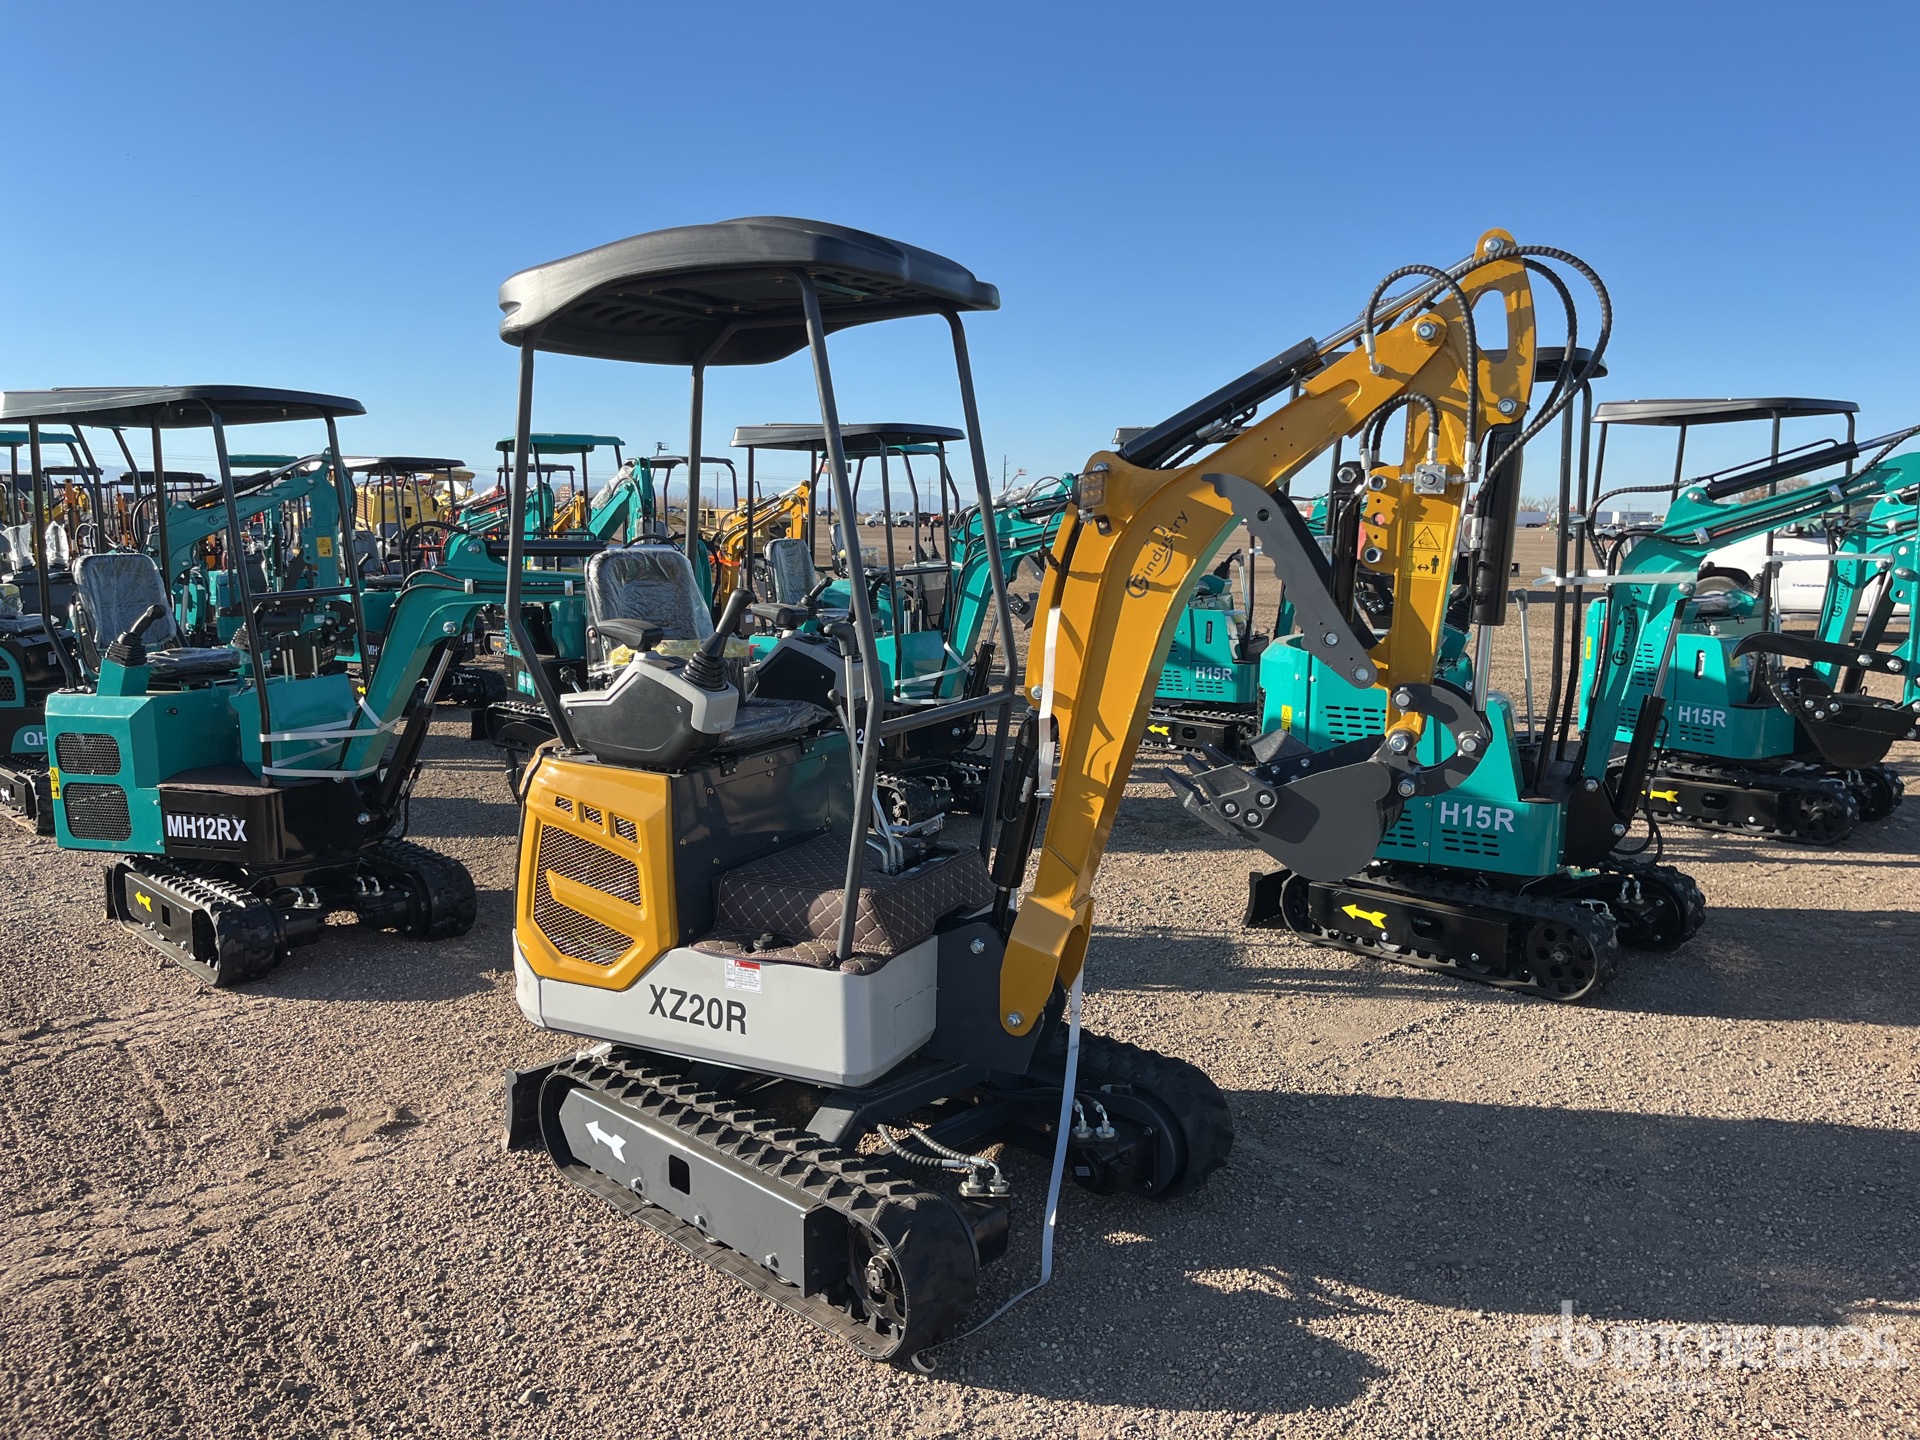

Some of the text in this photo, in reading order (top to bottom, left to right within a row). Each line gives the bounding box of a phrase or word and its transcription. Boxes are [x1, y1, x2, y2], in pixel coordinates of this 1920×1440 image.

[1195, 666, 1233, 682] H15R
[1678, 705, 1726, 728] H15R
[166, 814, 248, 842] MH12RX
[1440, 801, 1515, 833] H15R
[648, 983, 747, 1035] XZ20R
